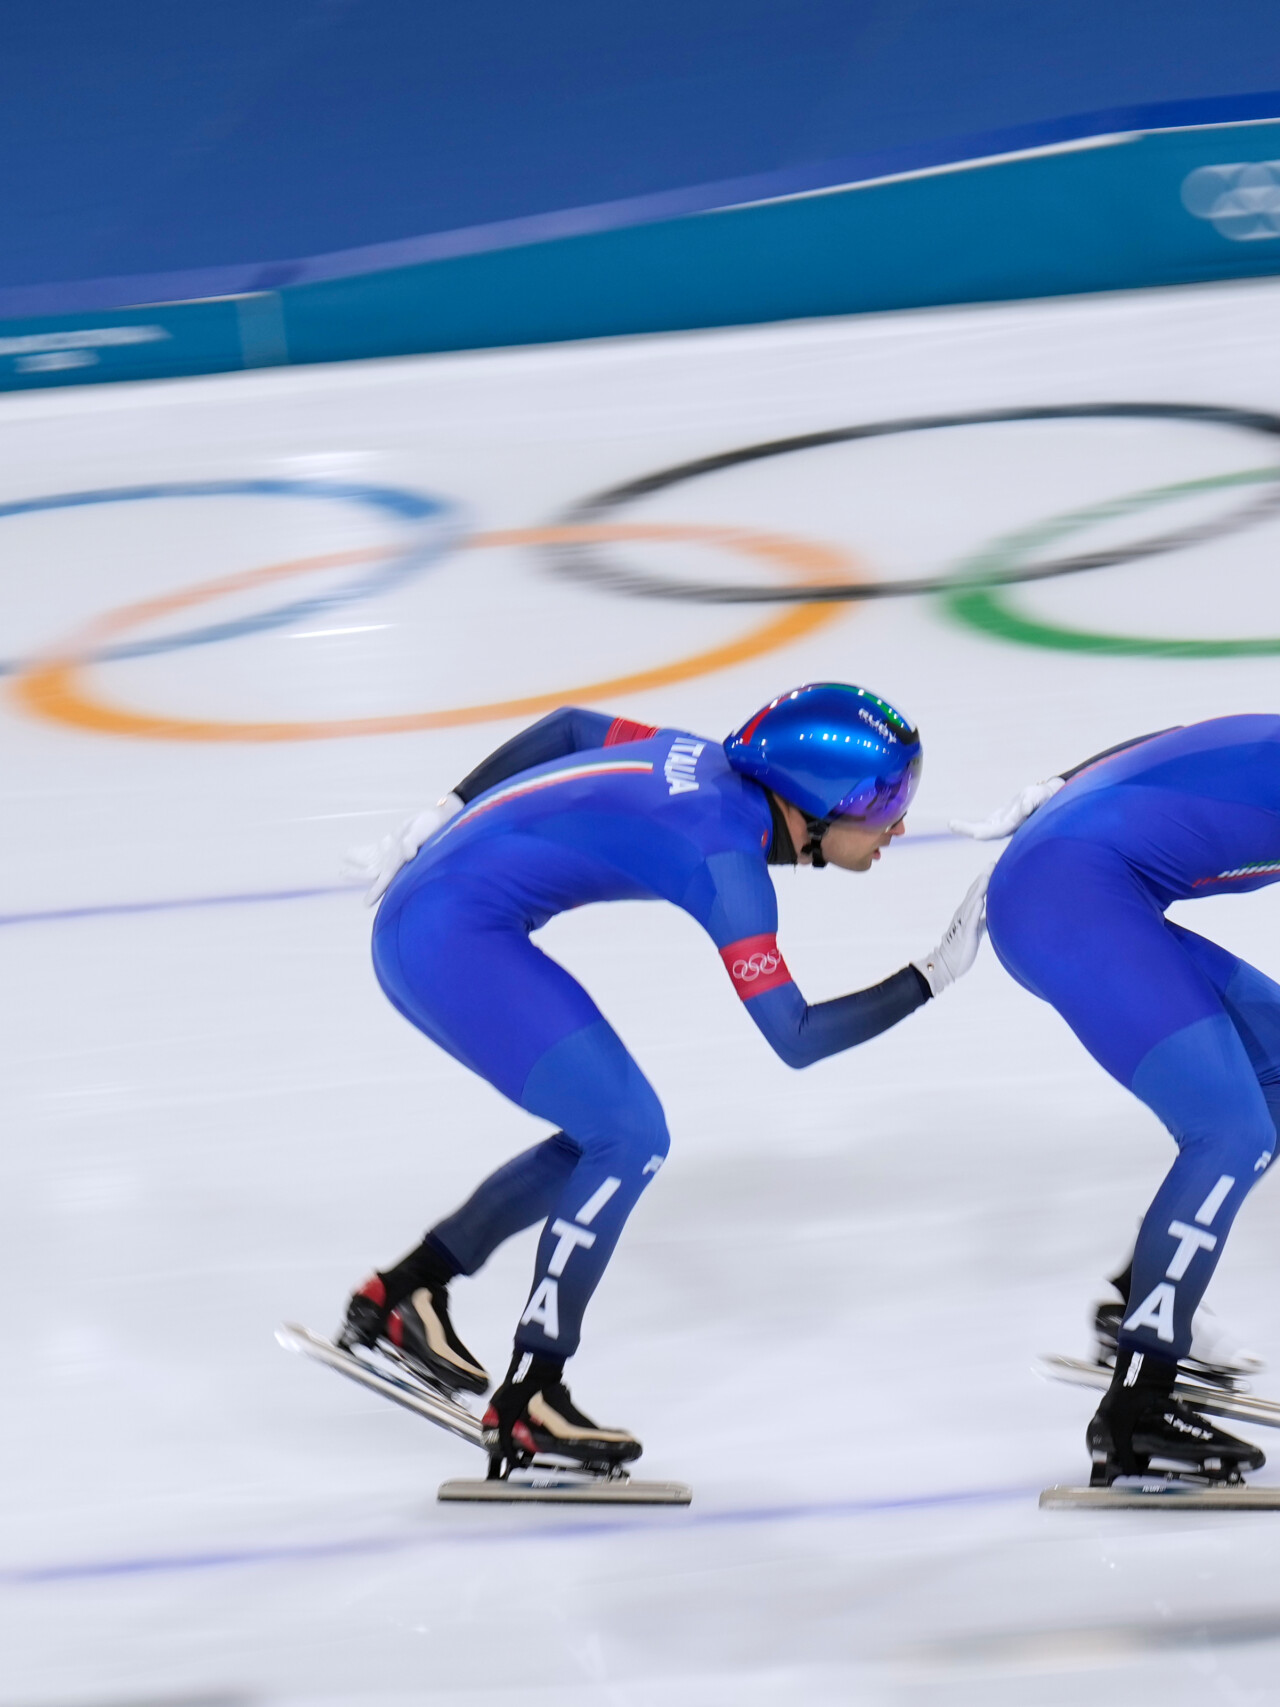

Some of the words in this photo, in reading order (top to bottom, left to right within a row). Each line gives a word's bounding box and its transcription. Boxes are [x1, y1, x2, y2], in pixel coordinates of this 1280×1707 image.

[663, 736, 707, 796] ITALIA
[519, 1175, 622, 1341] ITA
[1122, 1174, 1236, 1344] ITA
